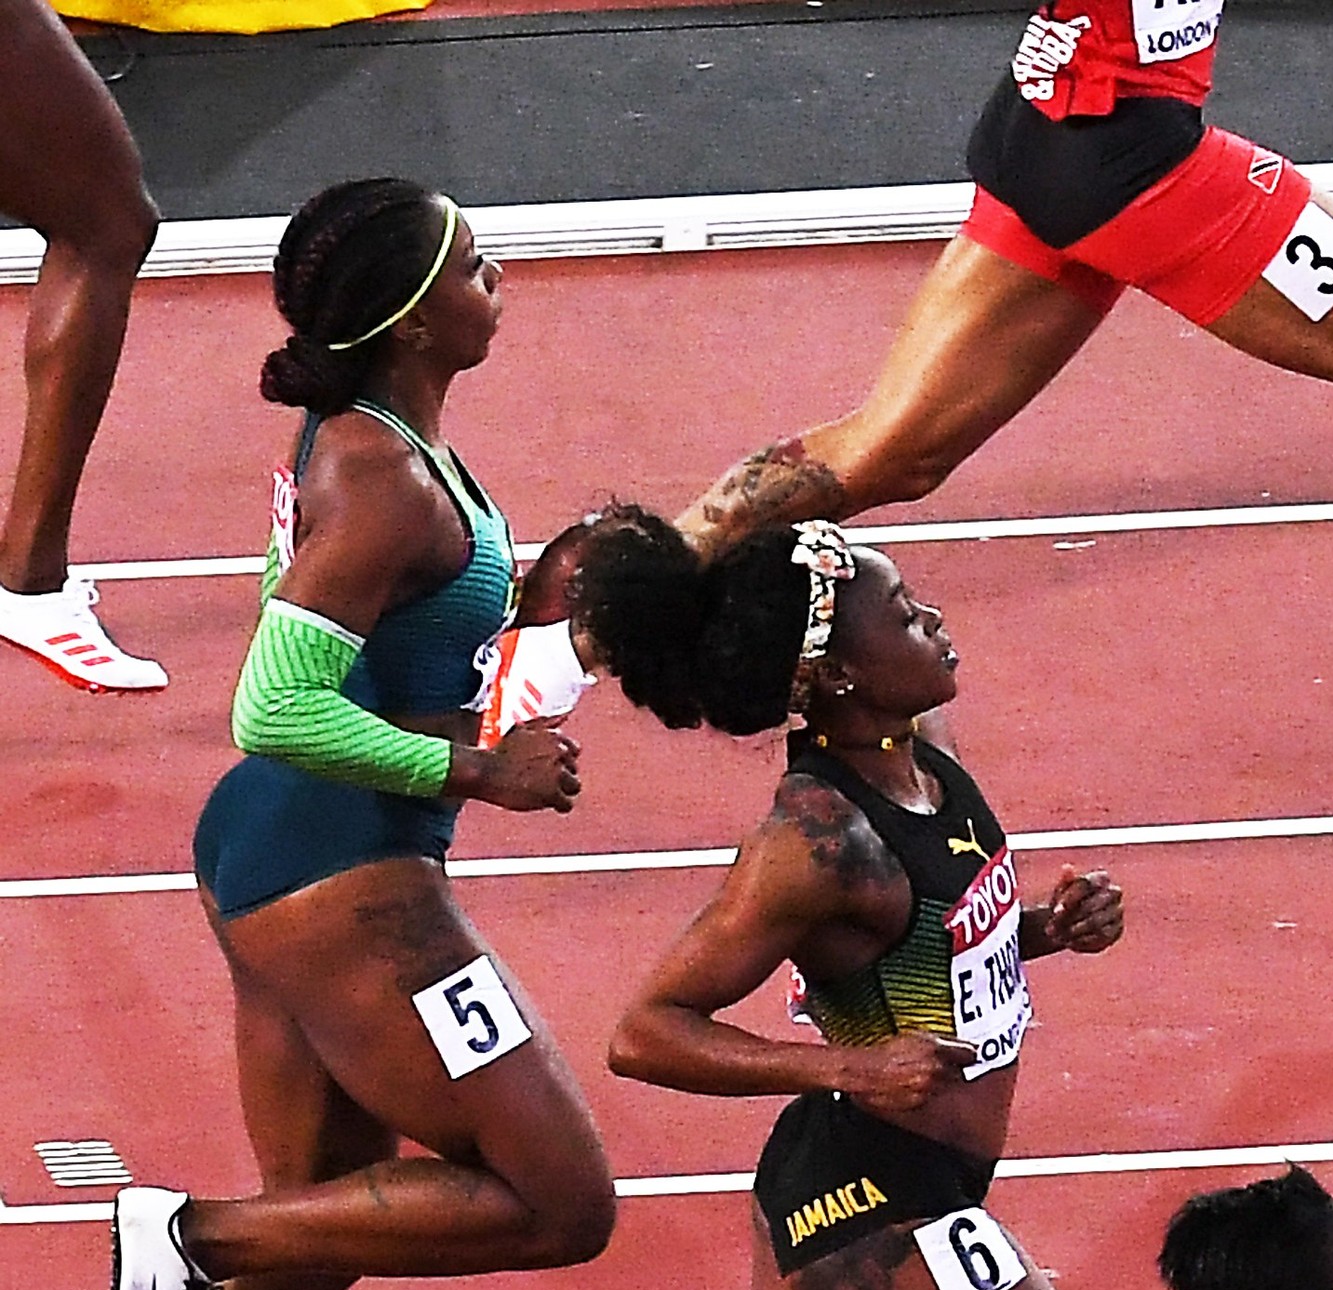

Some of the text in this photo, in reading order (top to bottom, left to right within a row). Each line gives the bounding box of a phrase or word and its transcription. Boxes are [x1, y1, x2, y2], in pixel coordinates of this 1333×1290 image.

[443, 976, 499, 1053] 5
[958, 969, 984, 1024] E.
[786, 1177, 888, 1247] JAMAICA
